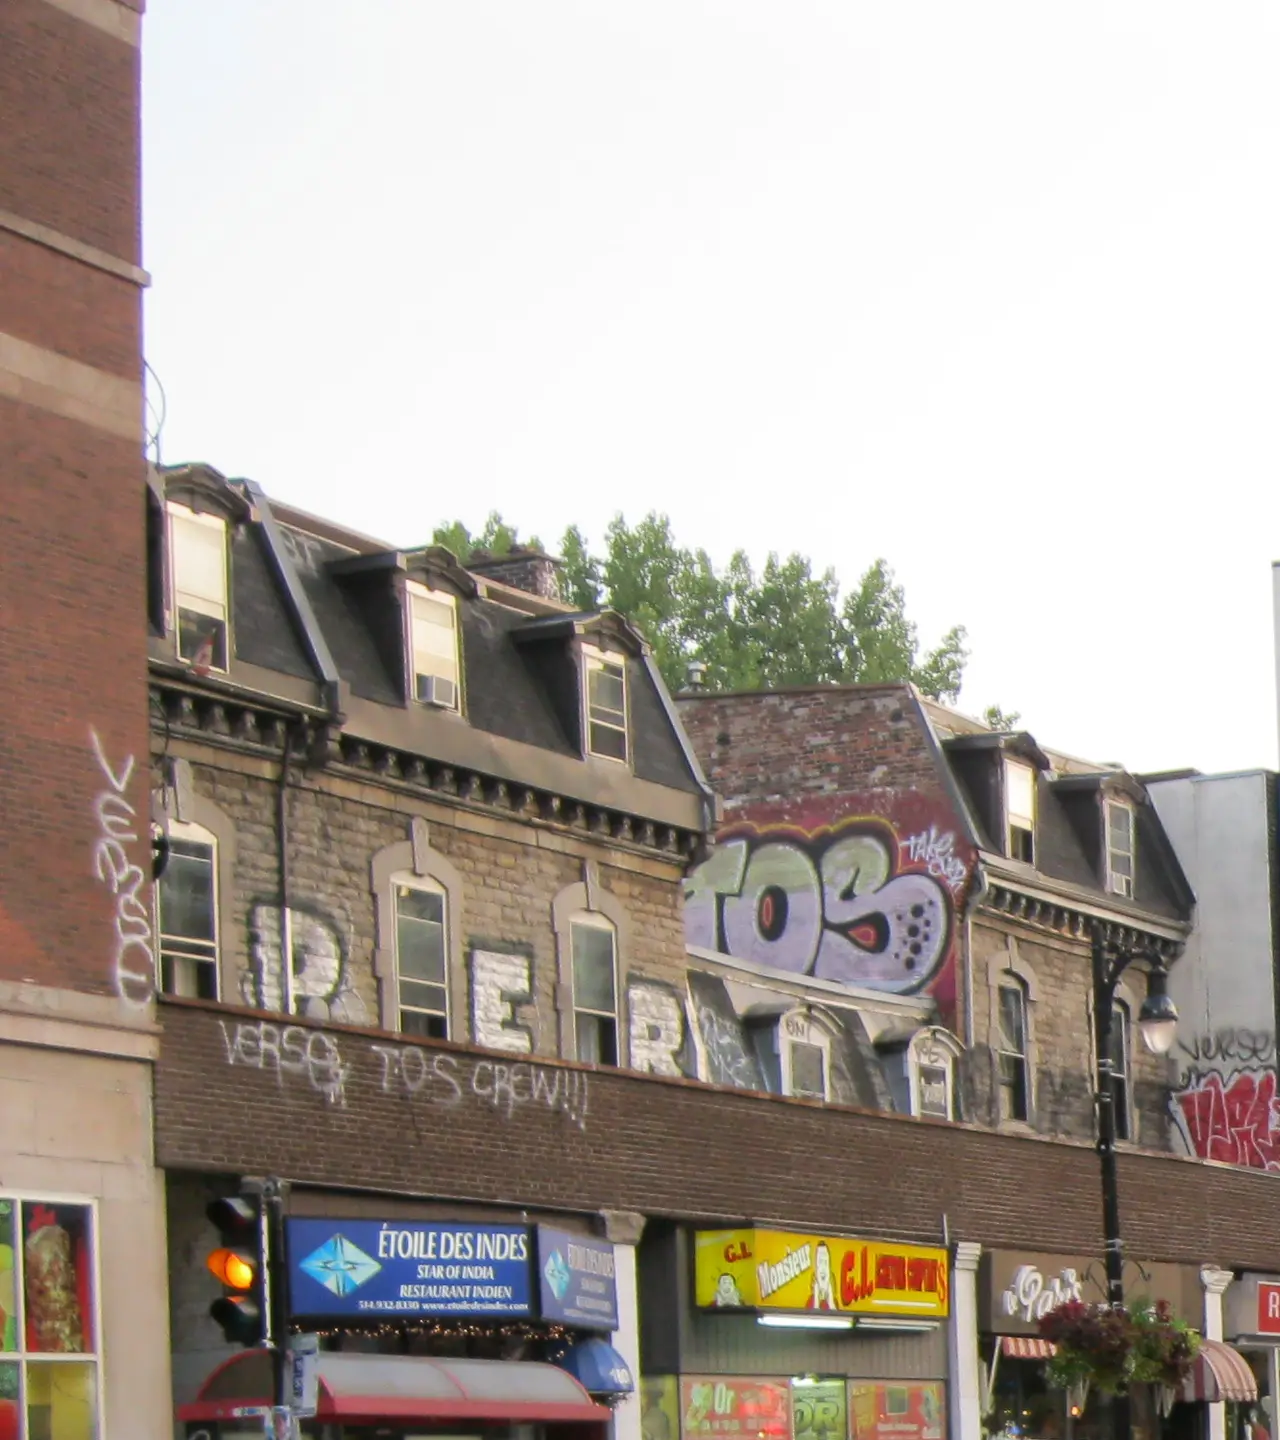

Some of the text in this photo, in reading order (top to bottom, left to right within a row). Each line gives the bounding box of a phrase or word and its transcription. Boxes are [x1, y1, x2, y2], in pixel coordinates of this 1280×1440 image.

[378, 1223, 528, 1261] ÉTOILE DES INDES
[417, 1264, 494, 1280] STAR OF INDIA
[757, 1243, 811, 1300] Monsieur
[399, 1284, 512, 1299] RESTAURANT INDIEN
